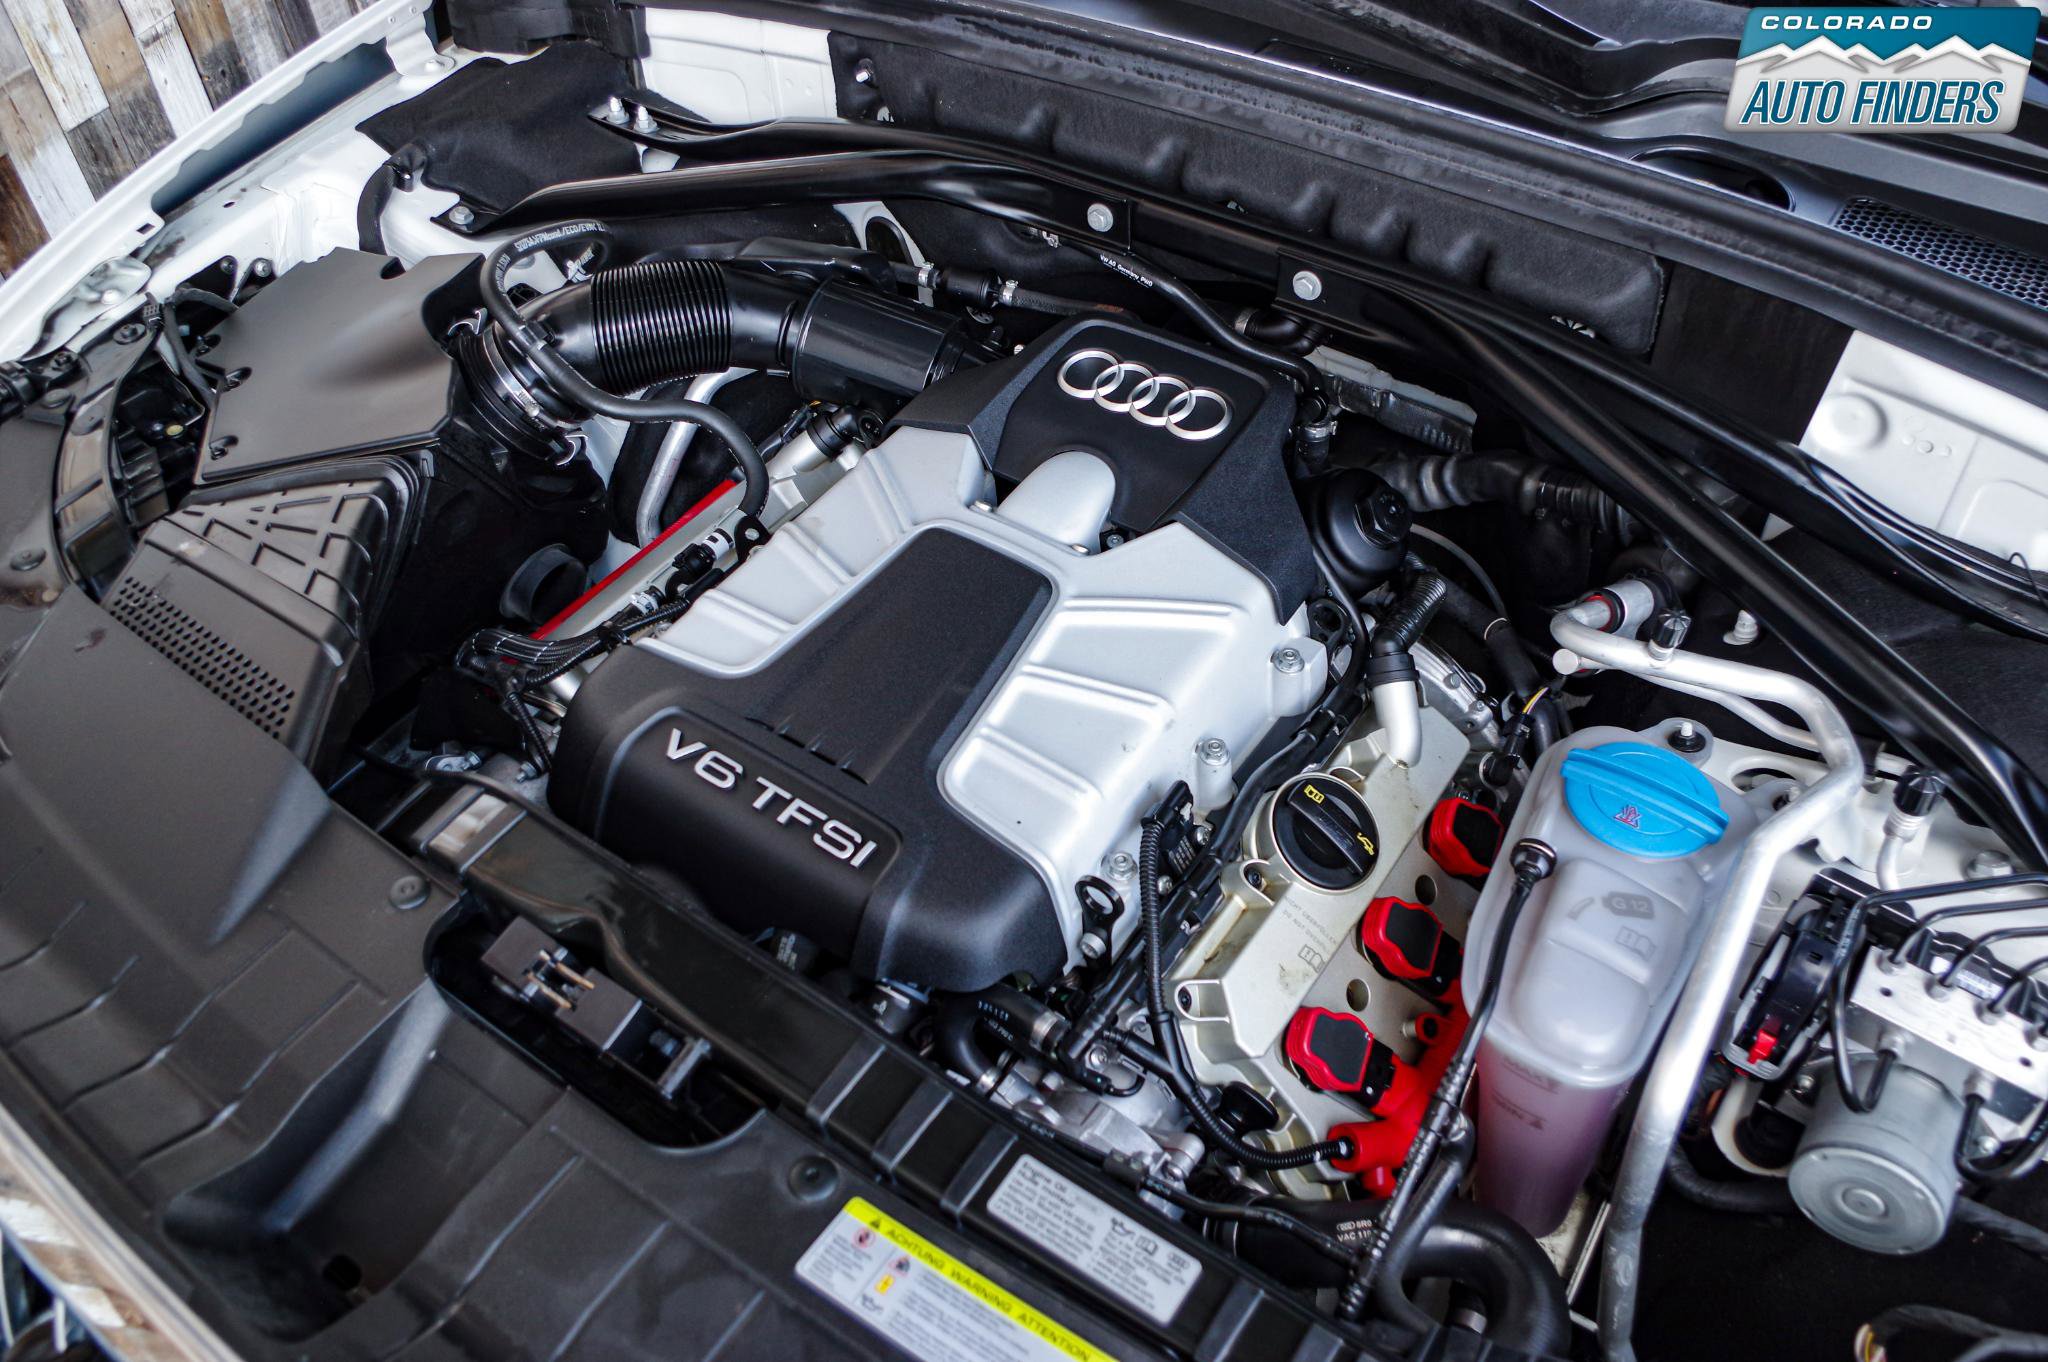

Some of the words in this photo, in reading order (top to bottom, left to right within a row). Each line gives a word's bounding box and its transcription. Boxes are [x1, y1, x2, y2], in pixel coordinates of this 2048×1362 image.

[1117, 265, 1140, 280] Germany
[666, 728, 744, 789] V6
[752, 776, 877, 868] TFSI
[1611, 897, 1627, 910] G
[1631, 899, 1652, 913] 12
[1337, 1232, 1356, 1242] VAC
[887, 1228, 946, 1270] ACHTUNG
[950, 1269, 1013, 1315] WARNING
[1016, 1311, 1092, 1362] ATTENTION
